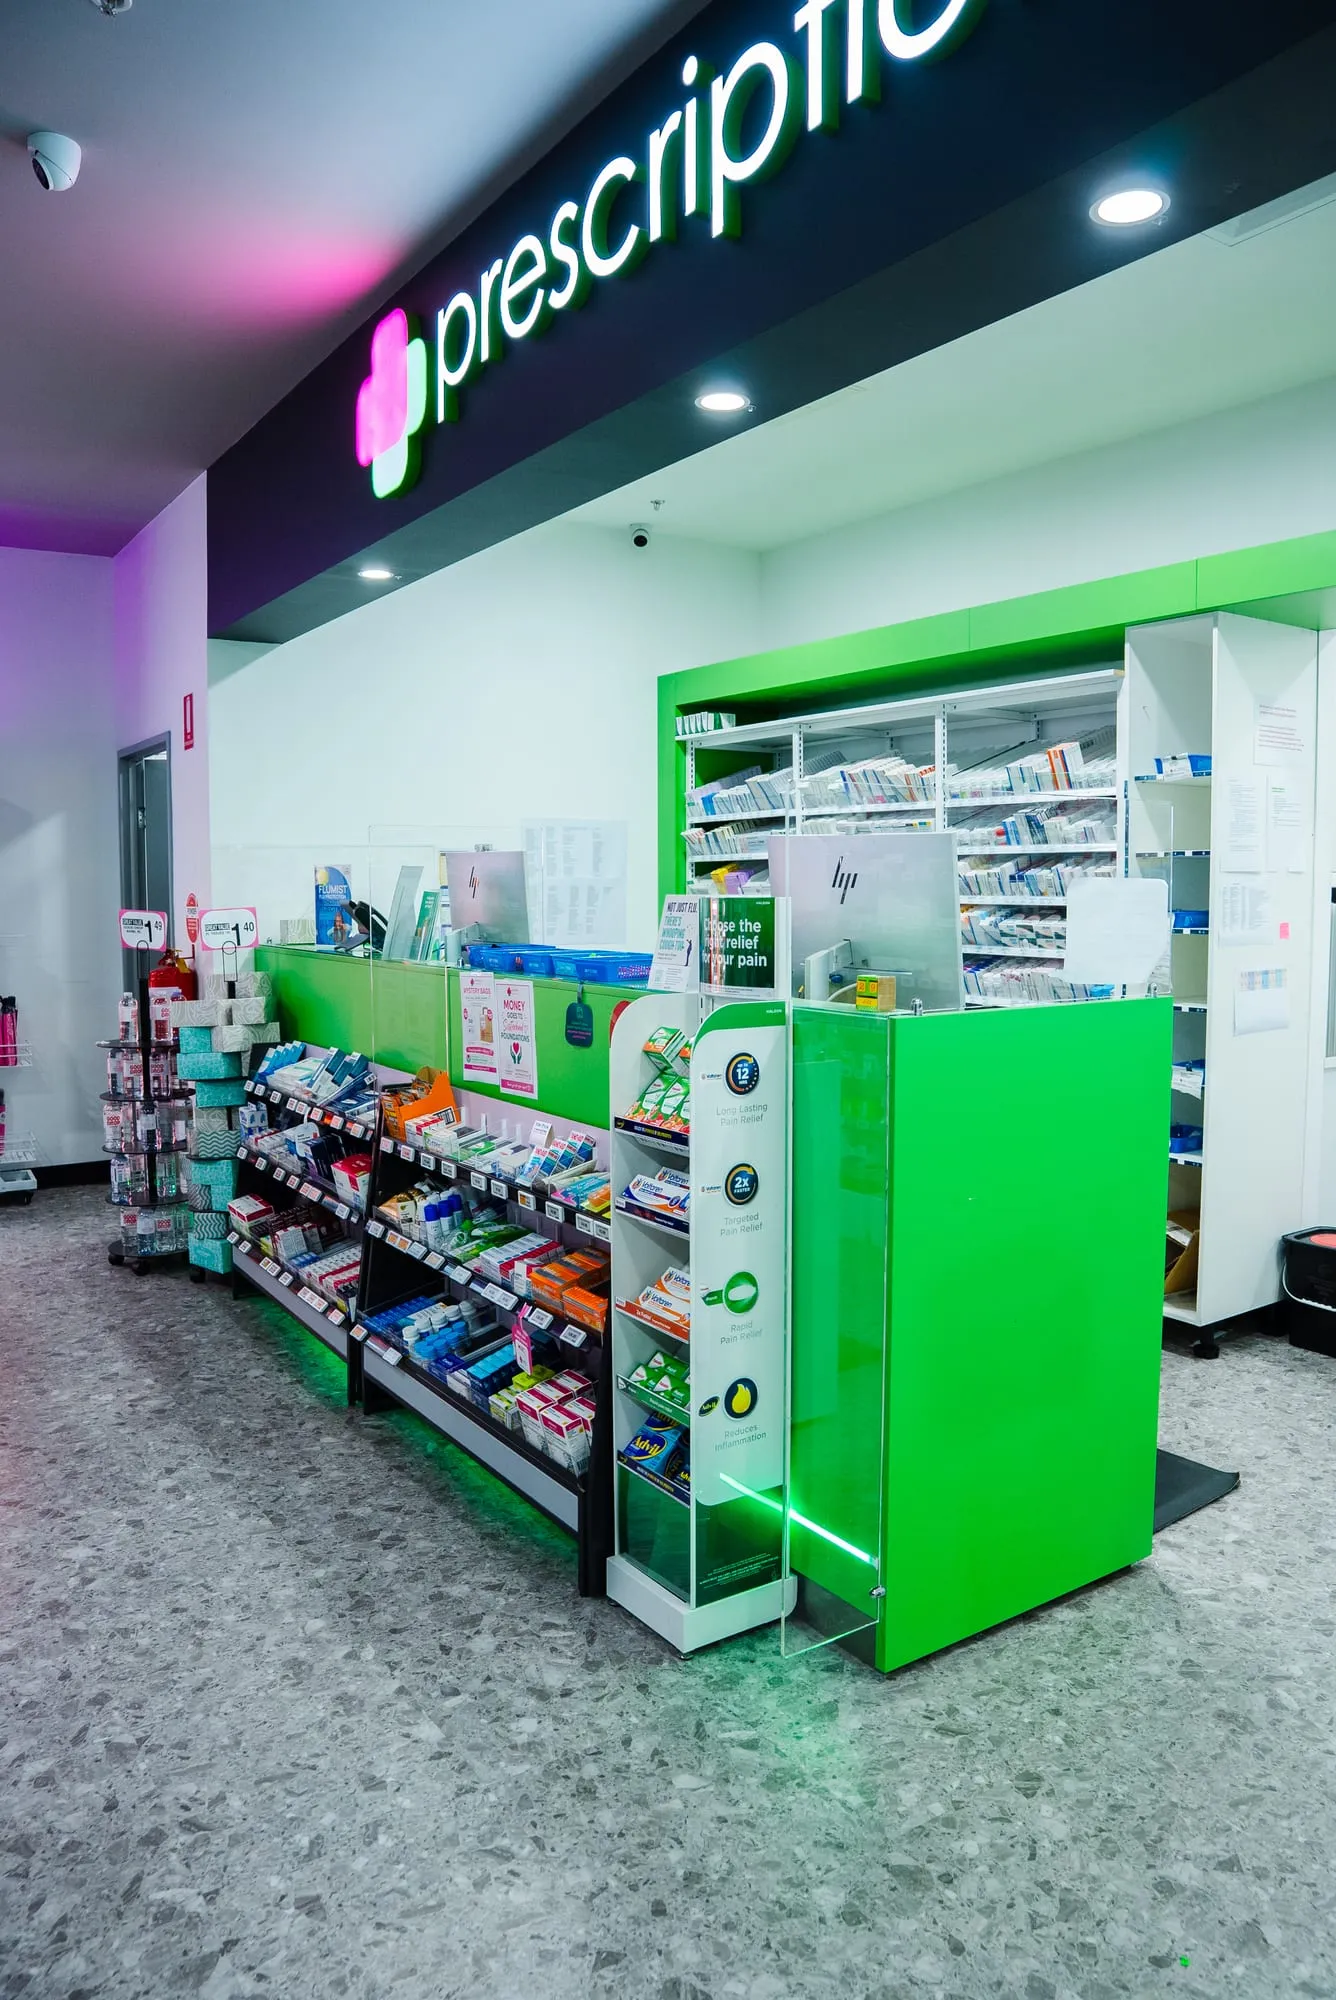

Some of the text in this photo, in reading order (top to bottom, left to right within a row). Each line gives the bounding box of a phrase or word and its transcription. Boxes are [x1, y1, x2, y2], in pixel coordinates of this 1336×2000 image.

[831, 855, 858, 905] hp
[318, 884, 348, 895] FLUMIST
[676, 902, 688, 912] JUST
[145, 920, 152, 942] 1
[739, 918, 762, 932] the
[232, 922, 254, 946] 1 40
[726, 935, 759, 950] relief
[738, 952, 768, 968] pain
[503, 1000, 525, 1011] MONEY
[736, 1068, 749, 1080] 12
[740, 1104, 768, 1113] Lasting
[720, 1113, 764, 1126] Pain Relief
[735, 1177, 749, 1188] 2x
[724, 1212, 759, 1225] Targeted
[720, 1222, 763, 1236] Pain Relief
[731, 1320, 752, 1332] Rapid
[720, 1328, 762, 1344] Pain Relief
[724, 1425, 758, 1439] Reduces
[632, 1436, 661, 1456] Advil
[715, 1432, 767, 1452] Inflammation
